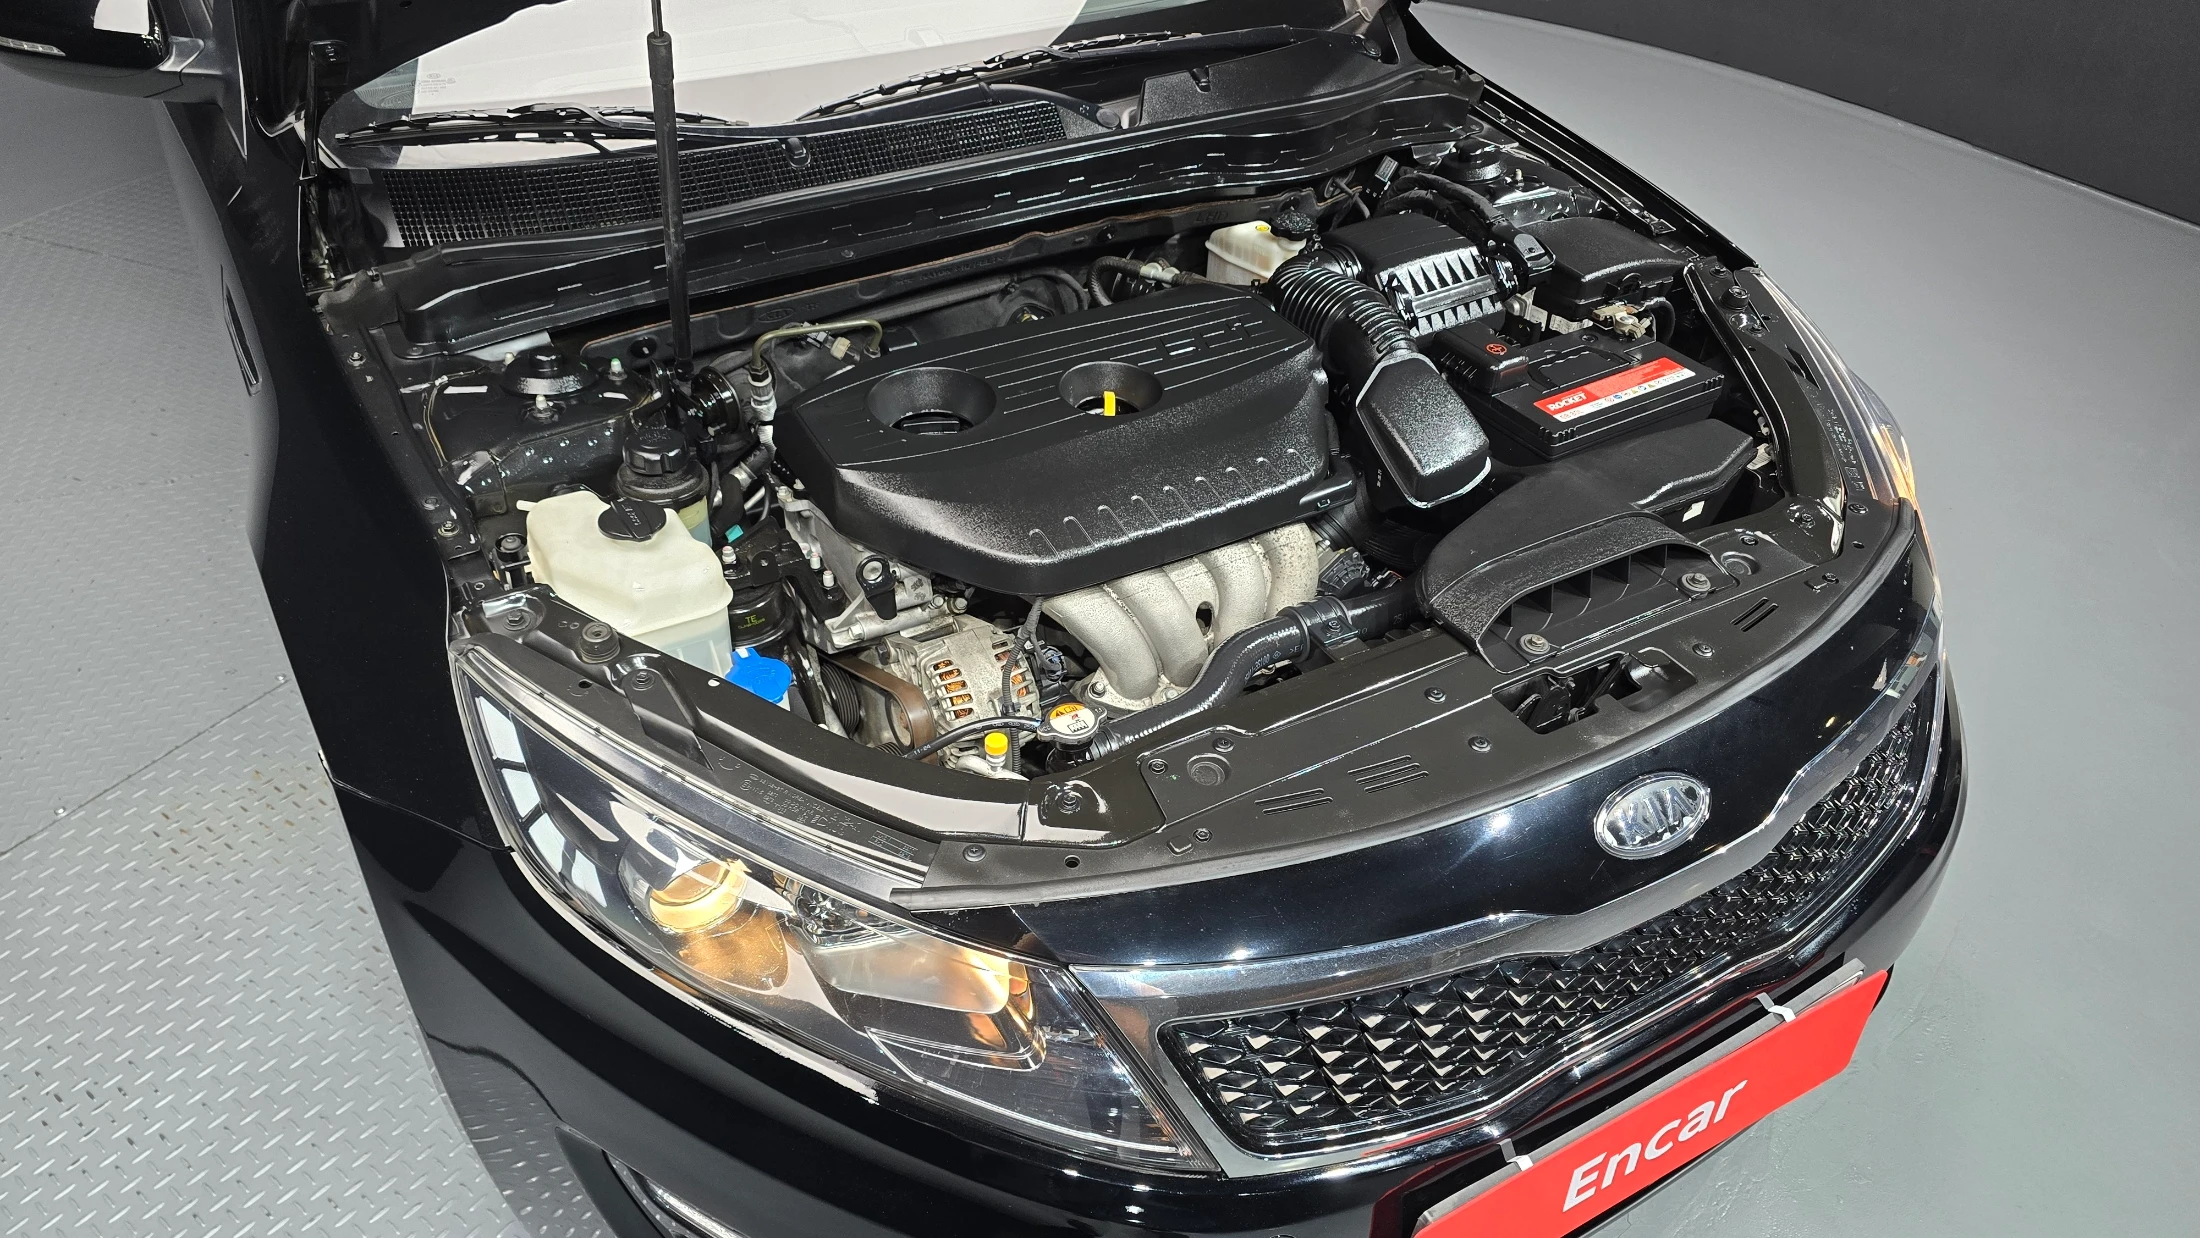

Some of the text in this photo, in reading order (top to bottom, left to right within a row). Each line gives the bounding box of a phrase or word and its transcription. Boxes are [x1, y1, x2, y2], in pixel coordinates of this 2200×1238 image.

[1546, 392, 1587, 411] ROCKET
[1617, 786, 1697, 846] KIA
[1562, 1079, 1748, 1213] Encar
